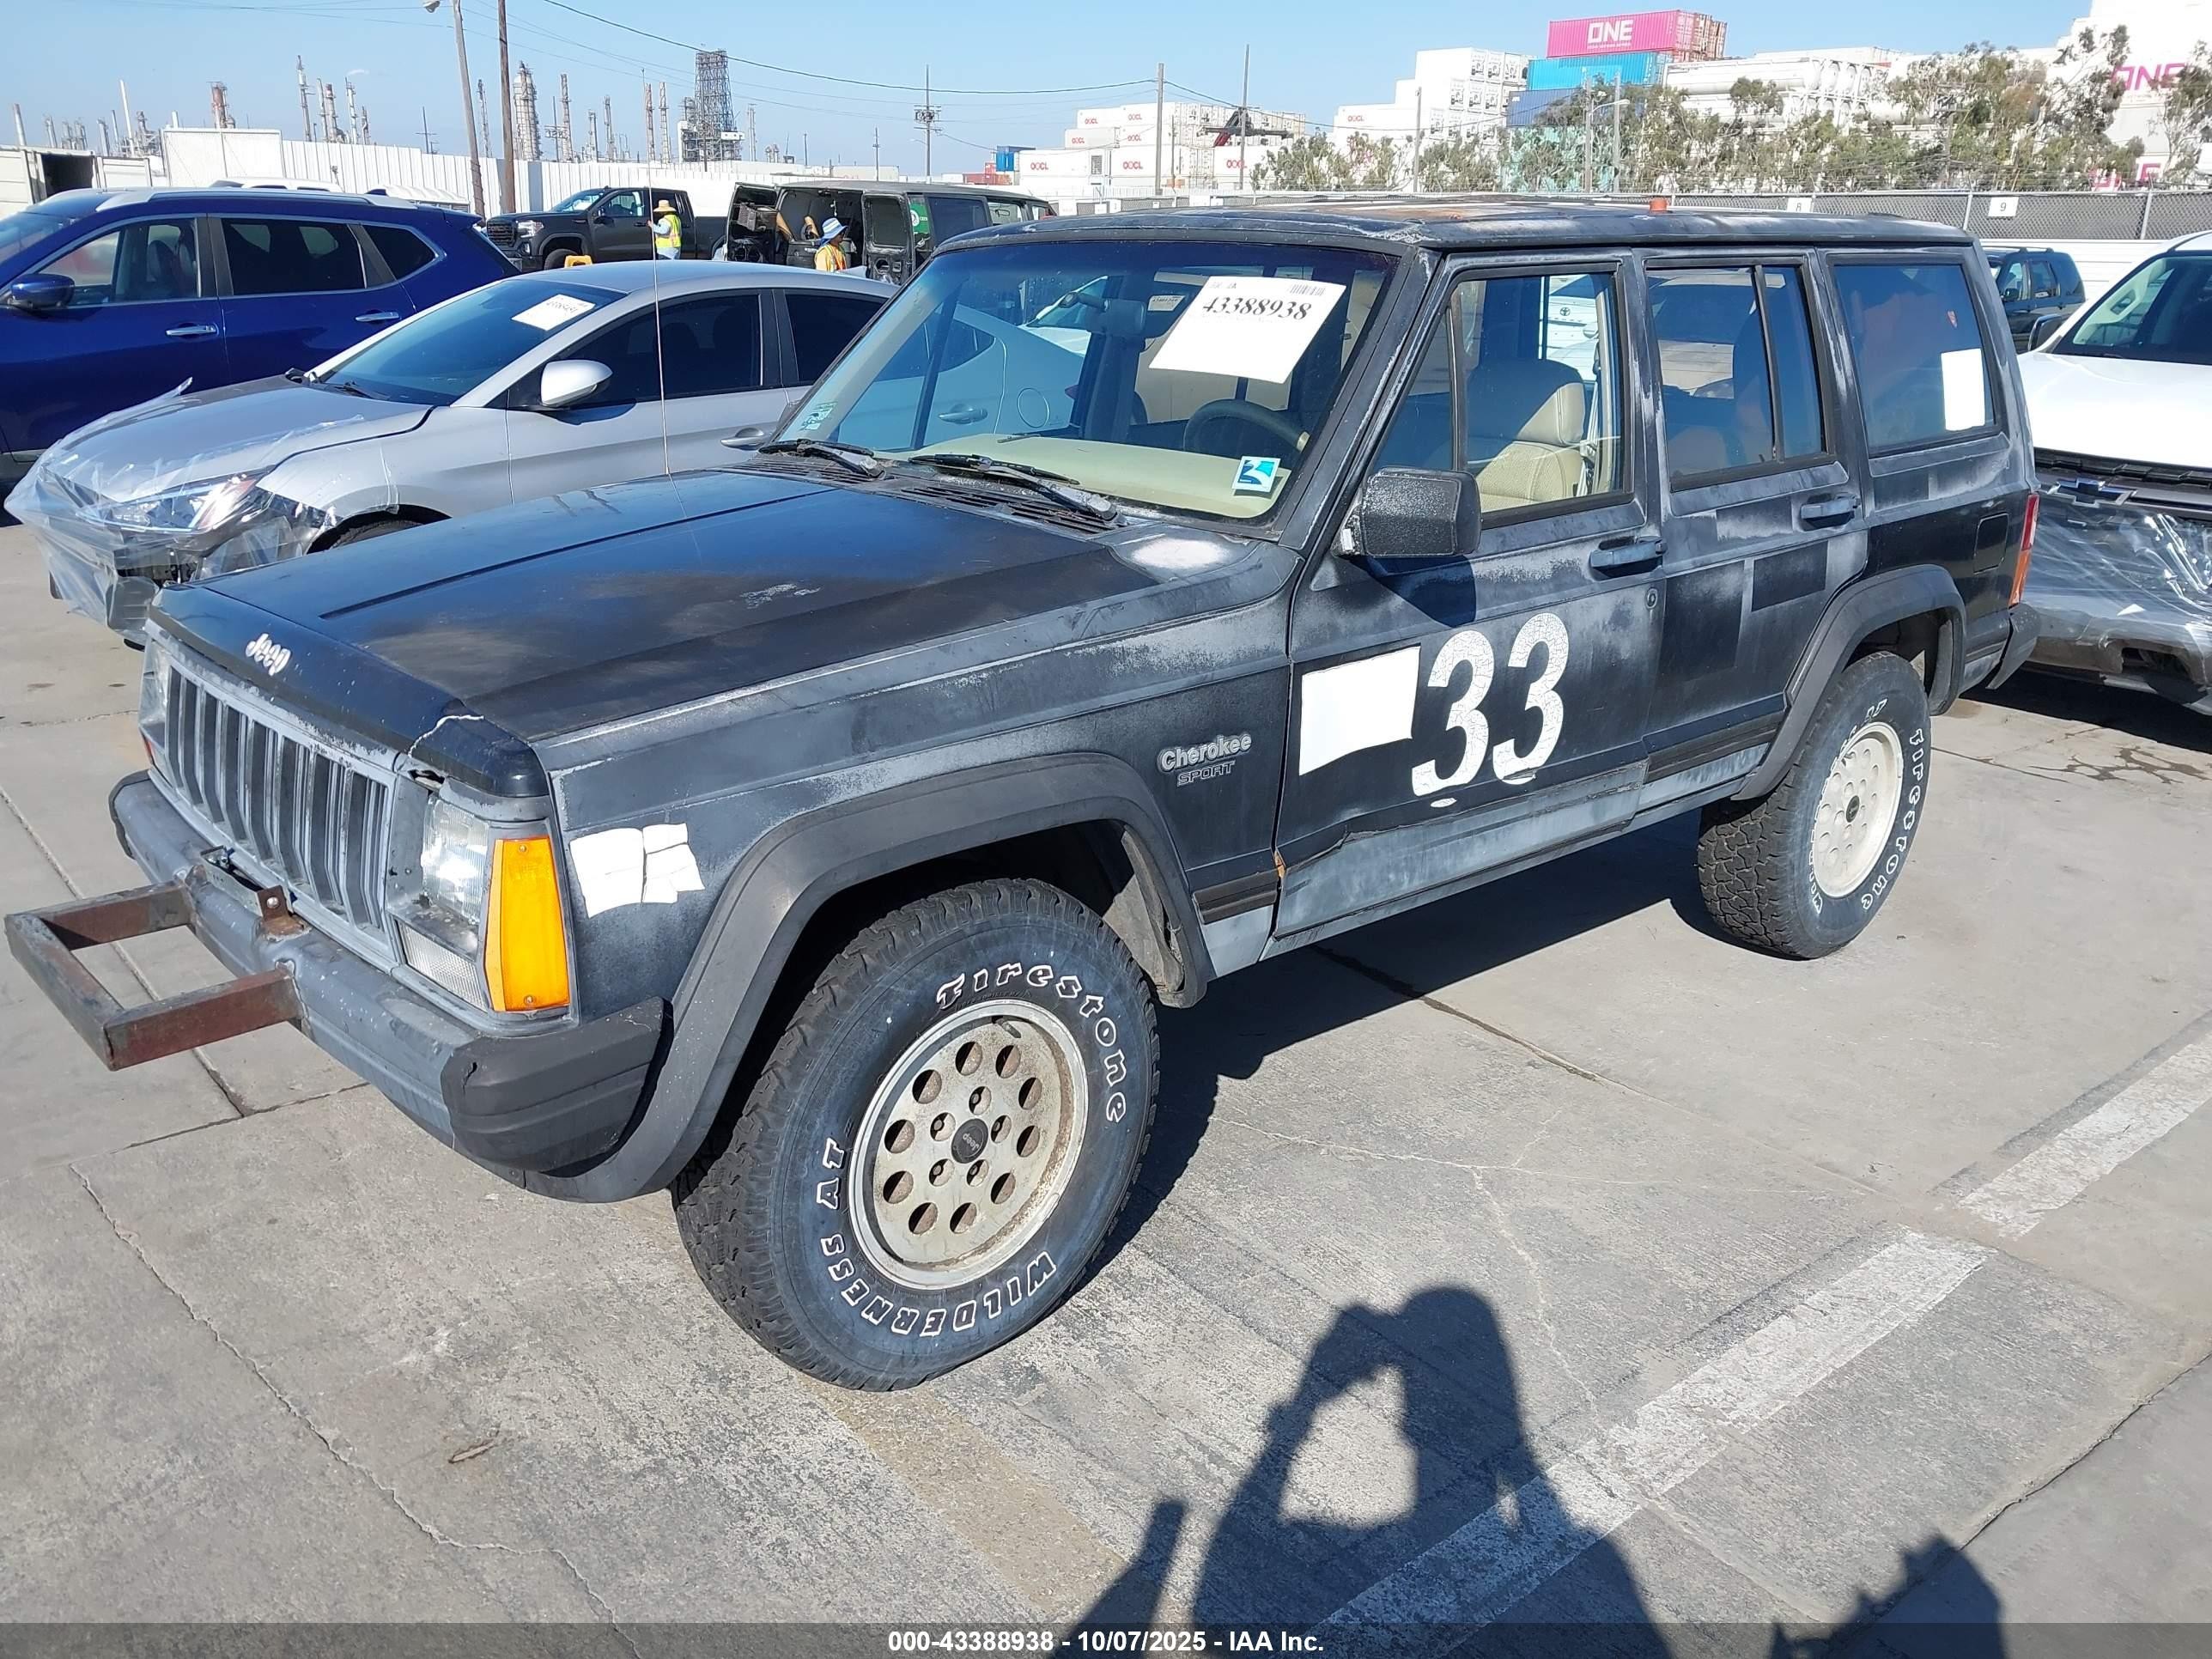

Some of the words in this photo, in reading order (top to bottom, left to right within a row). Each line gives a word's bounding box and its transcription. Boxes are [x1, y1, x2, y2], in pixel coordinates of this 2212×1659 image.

[1587, 19, 1635, 44] ONE
[1030, 161, 1049, 171] OOCL
[1123, 161, 1144, 170] OOCL
[2000, 202, 2007, 212] 9
[1203, 295, 1312, 321] 43388938
[246, 633, 293, 677] Jeep
[1411, 612, 1570, 799] 33
[1159, 734, 1253, 772] Cherokee
[1177, 760, 1237, 787] SPORT
[937, 963, 1127, 1123] Firestone
[820, 1232, 1057, 1336] WILDERNESS
